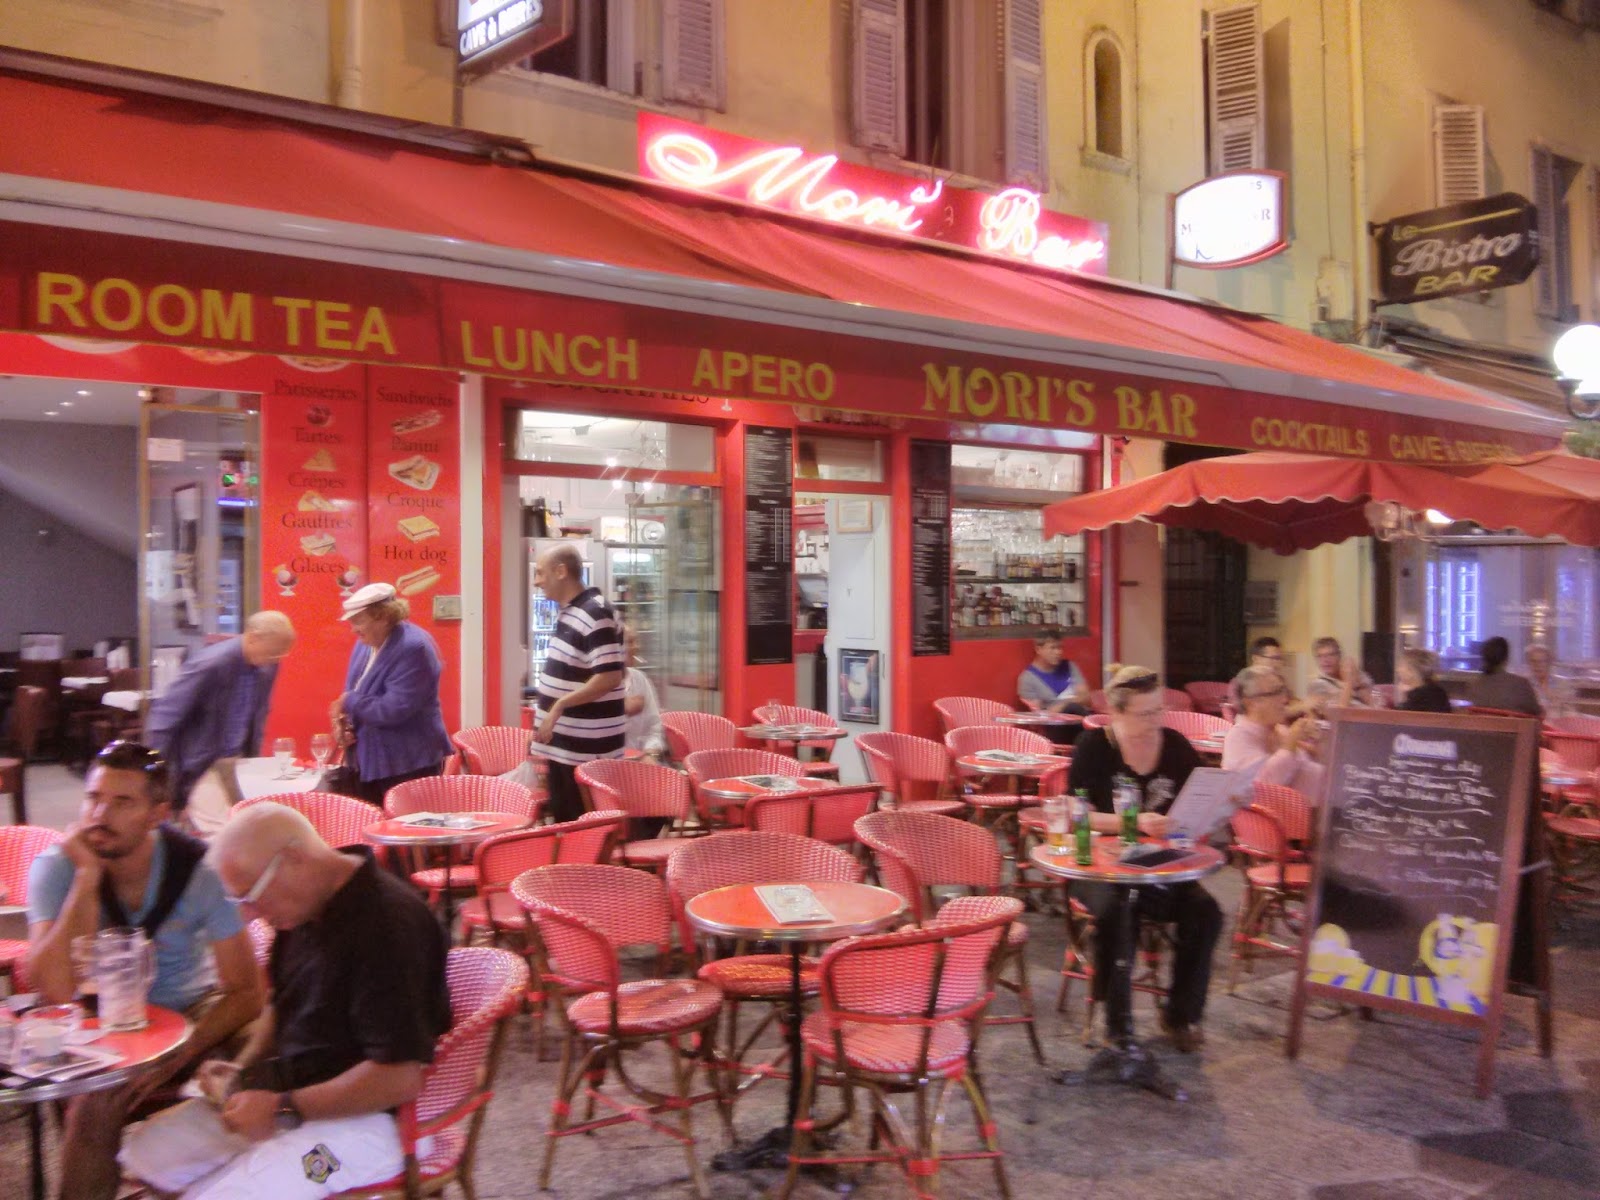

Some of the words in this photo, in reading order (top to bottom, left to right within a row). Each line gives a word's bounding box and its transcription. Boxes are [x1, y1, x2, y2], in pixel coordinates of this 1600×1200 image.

[1391, 232, 1522, 276] Bistro
[1413, 265, 1500, 295] BAR
[37, 271, 254, 342] ROOM
[272, 297, 397, 356] TEA
[460, 320, 638, 381] LUNCH
[692, 348, 834, 401] APERO
[921, 362, 1097, 427] MORI'S
[1114, 385, 1198, 439] BAR
[1251, 417, 1368, 456] COCKTAILS
[1389, 432, 1444, 461] CAVE
[387, 491, 443, 511] Croque
[291, 556, 345, 574] Glaces
[384, 545, 415, 561] Hot
[420, 545, 448, 563] dog
